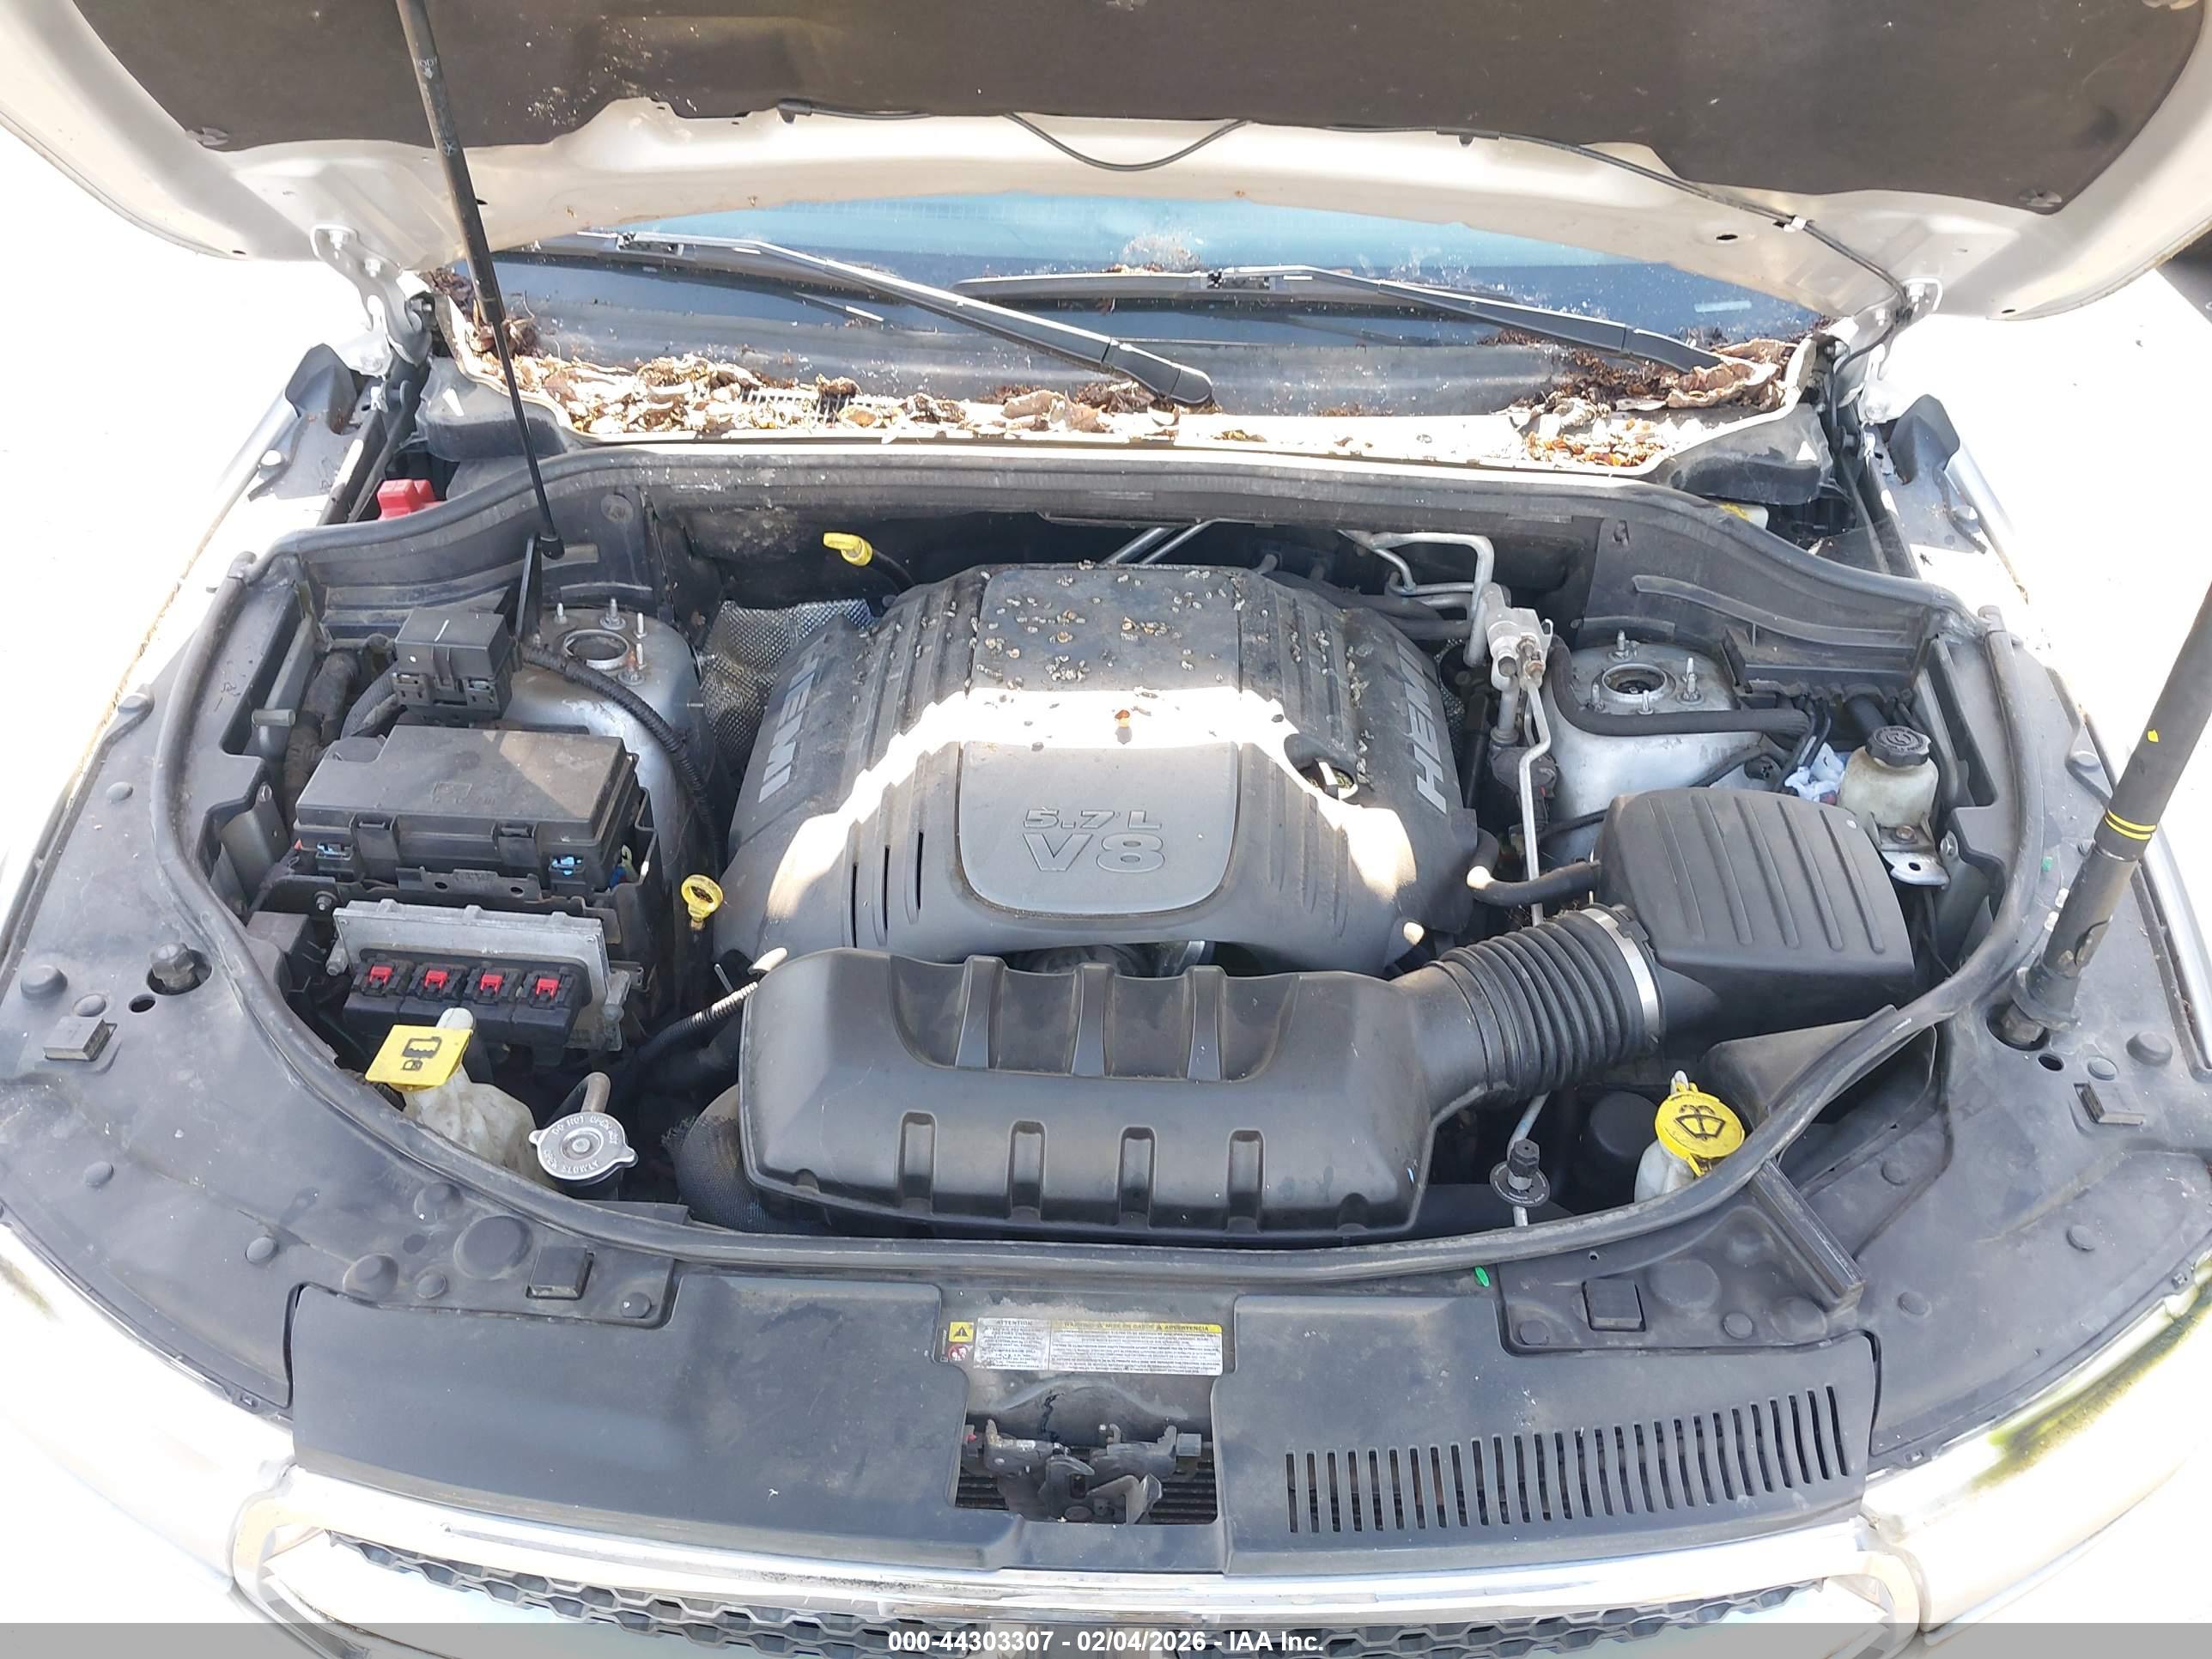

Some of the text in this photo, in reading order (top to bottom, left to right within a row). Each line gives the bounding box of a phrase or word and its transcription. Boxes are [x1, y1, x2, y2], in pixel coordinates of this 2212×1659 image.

[1396, 641, 1447, 814] HEMI
[1022, 832, 1165, 873] V8
[551, 1124, 564, 1135] DO
[567, 1115, 585, 1127] NOT
[562, 1160, 599, 1174] SLOWLY
